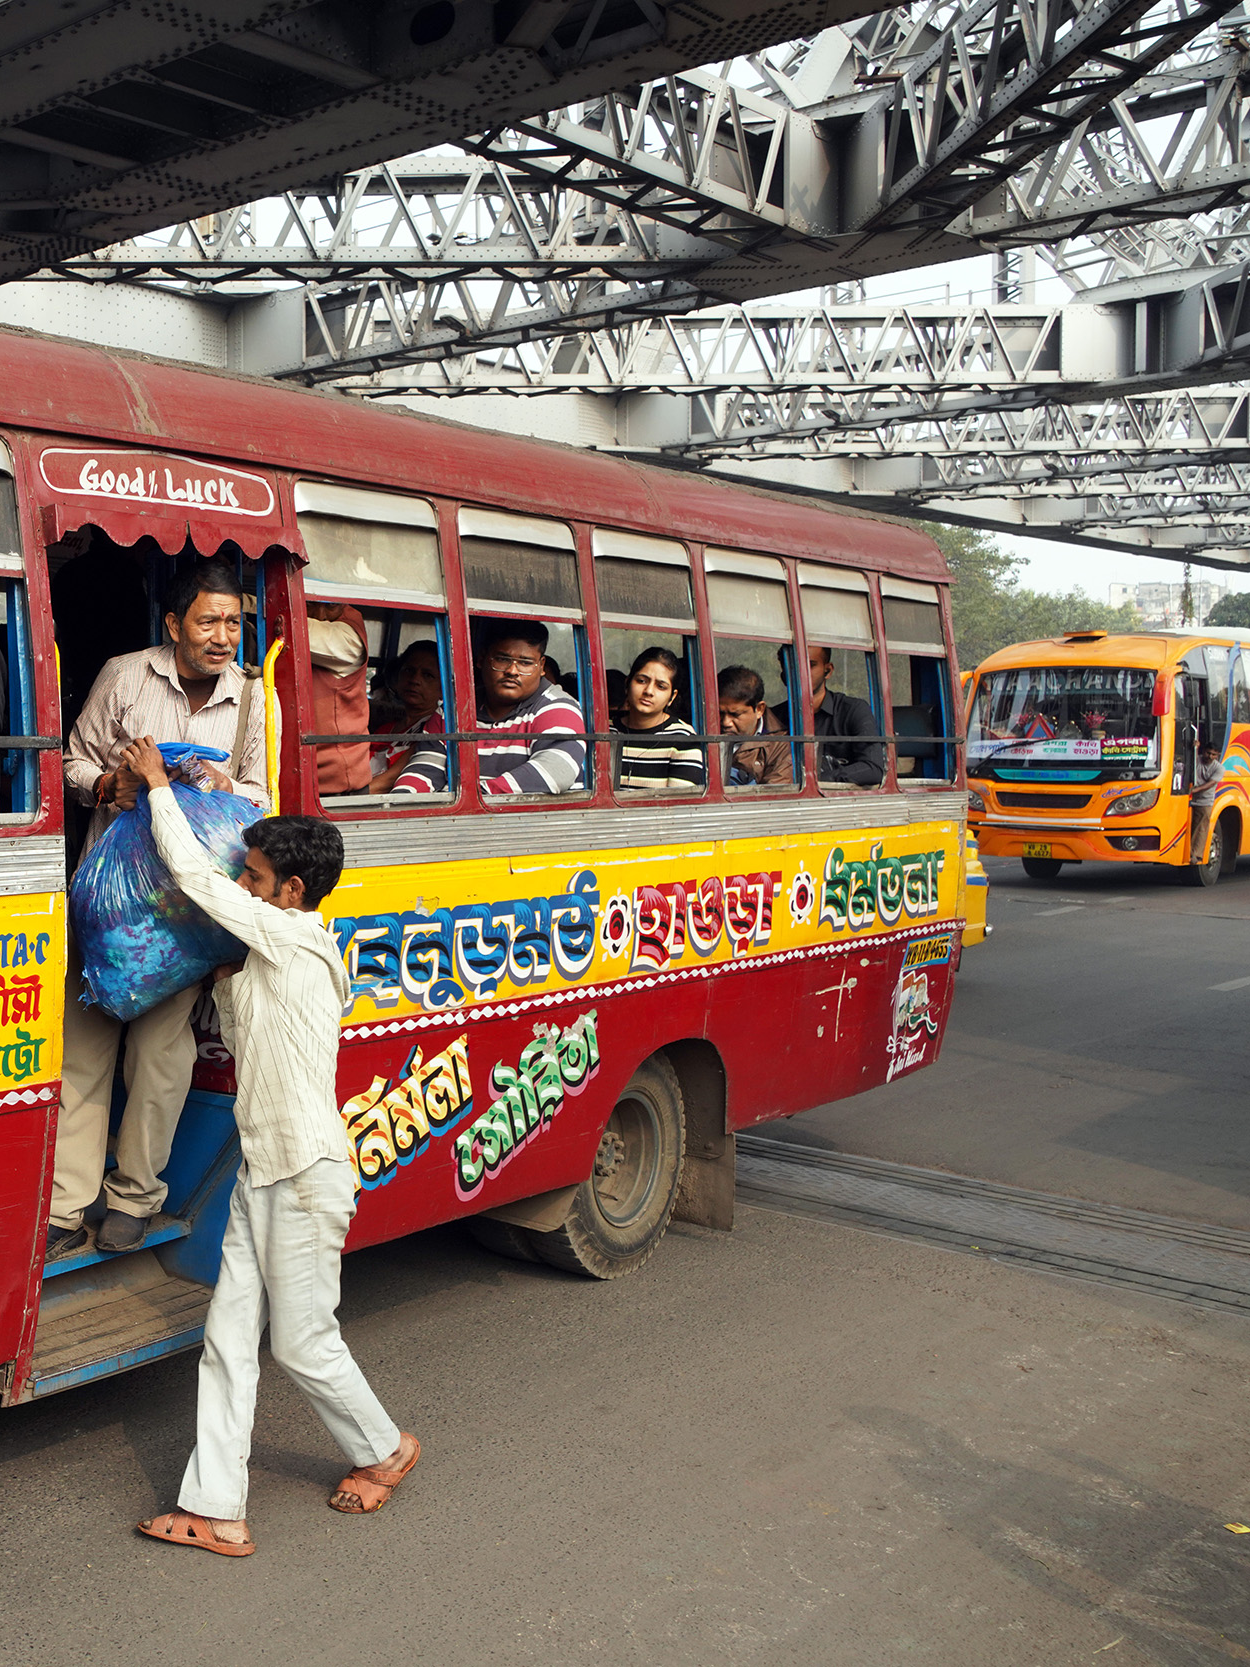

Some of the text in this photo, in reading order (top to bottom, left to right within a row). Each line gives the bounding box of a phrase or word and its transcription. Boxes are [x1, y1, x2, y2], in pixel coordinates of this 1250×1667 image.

[79, 459, 240, 508] Good Luck
[817, 841, 945, 933] ধর্মতলা
